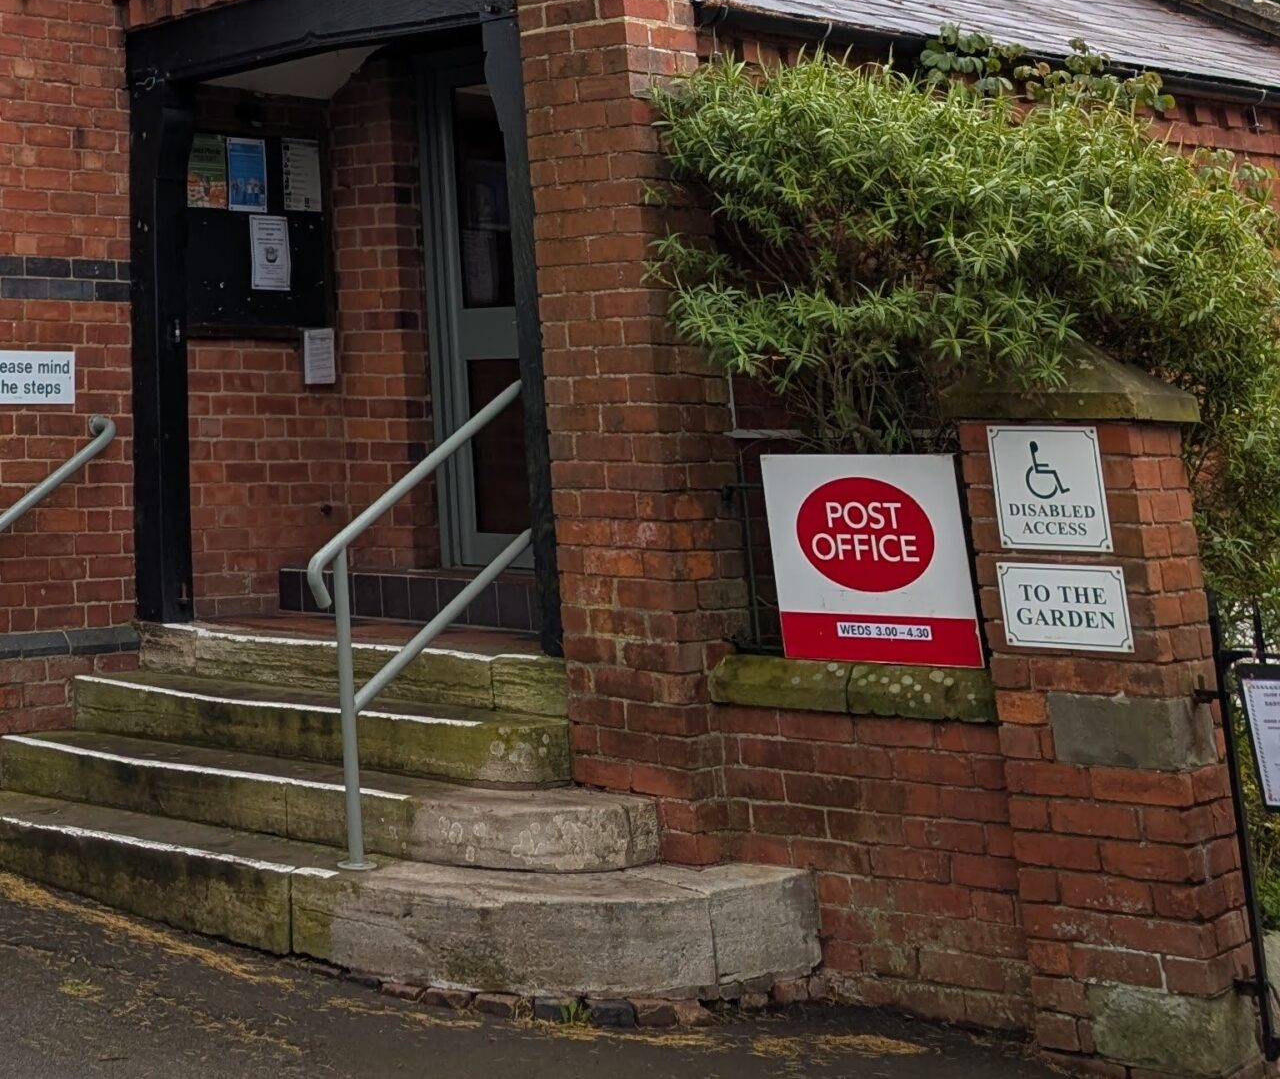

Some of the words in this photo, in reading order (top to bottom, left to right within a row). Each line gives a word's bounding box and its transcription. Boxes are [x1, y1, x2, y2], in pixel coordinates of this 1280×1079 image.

[37, 359, 70, 375] mind
[23, 380, 62, 399] steps
[825, 501, 902, 530] POST
[1008, 503, 1096, 519] DISABLED
[1022, 520, 1088, 536] ACCESS
[811, 532, 921, 563] OFFICE
[1018, 584, 1051, 603] TO
[1056, 585, 1108, 606] THE
[1016, 607, 1117, 630] GARDEN
[839, 624, 872, 636] WEDS
